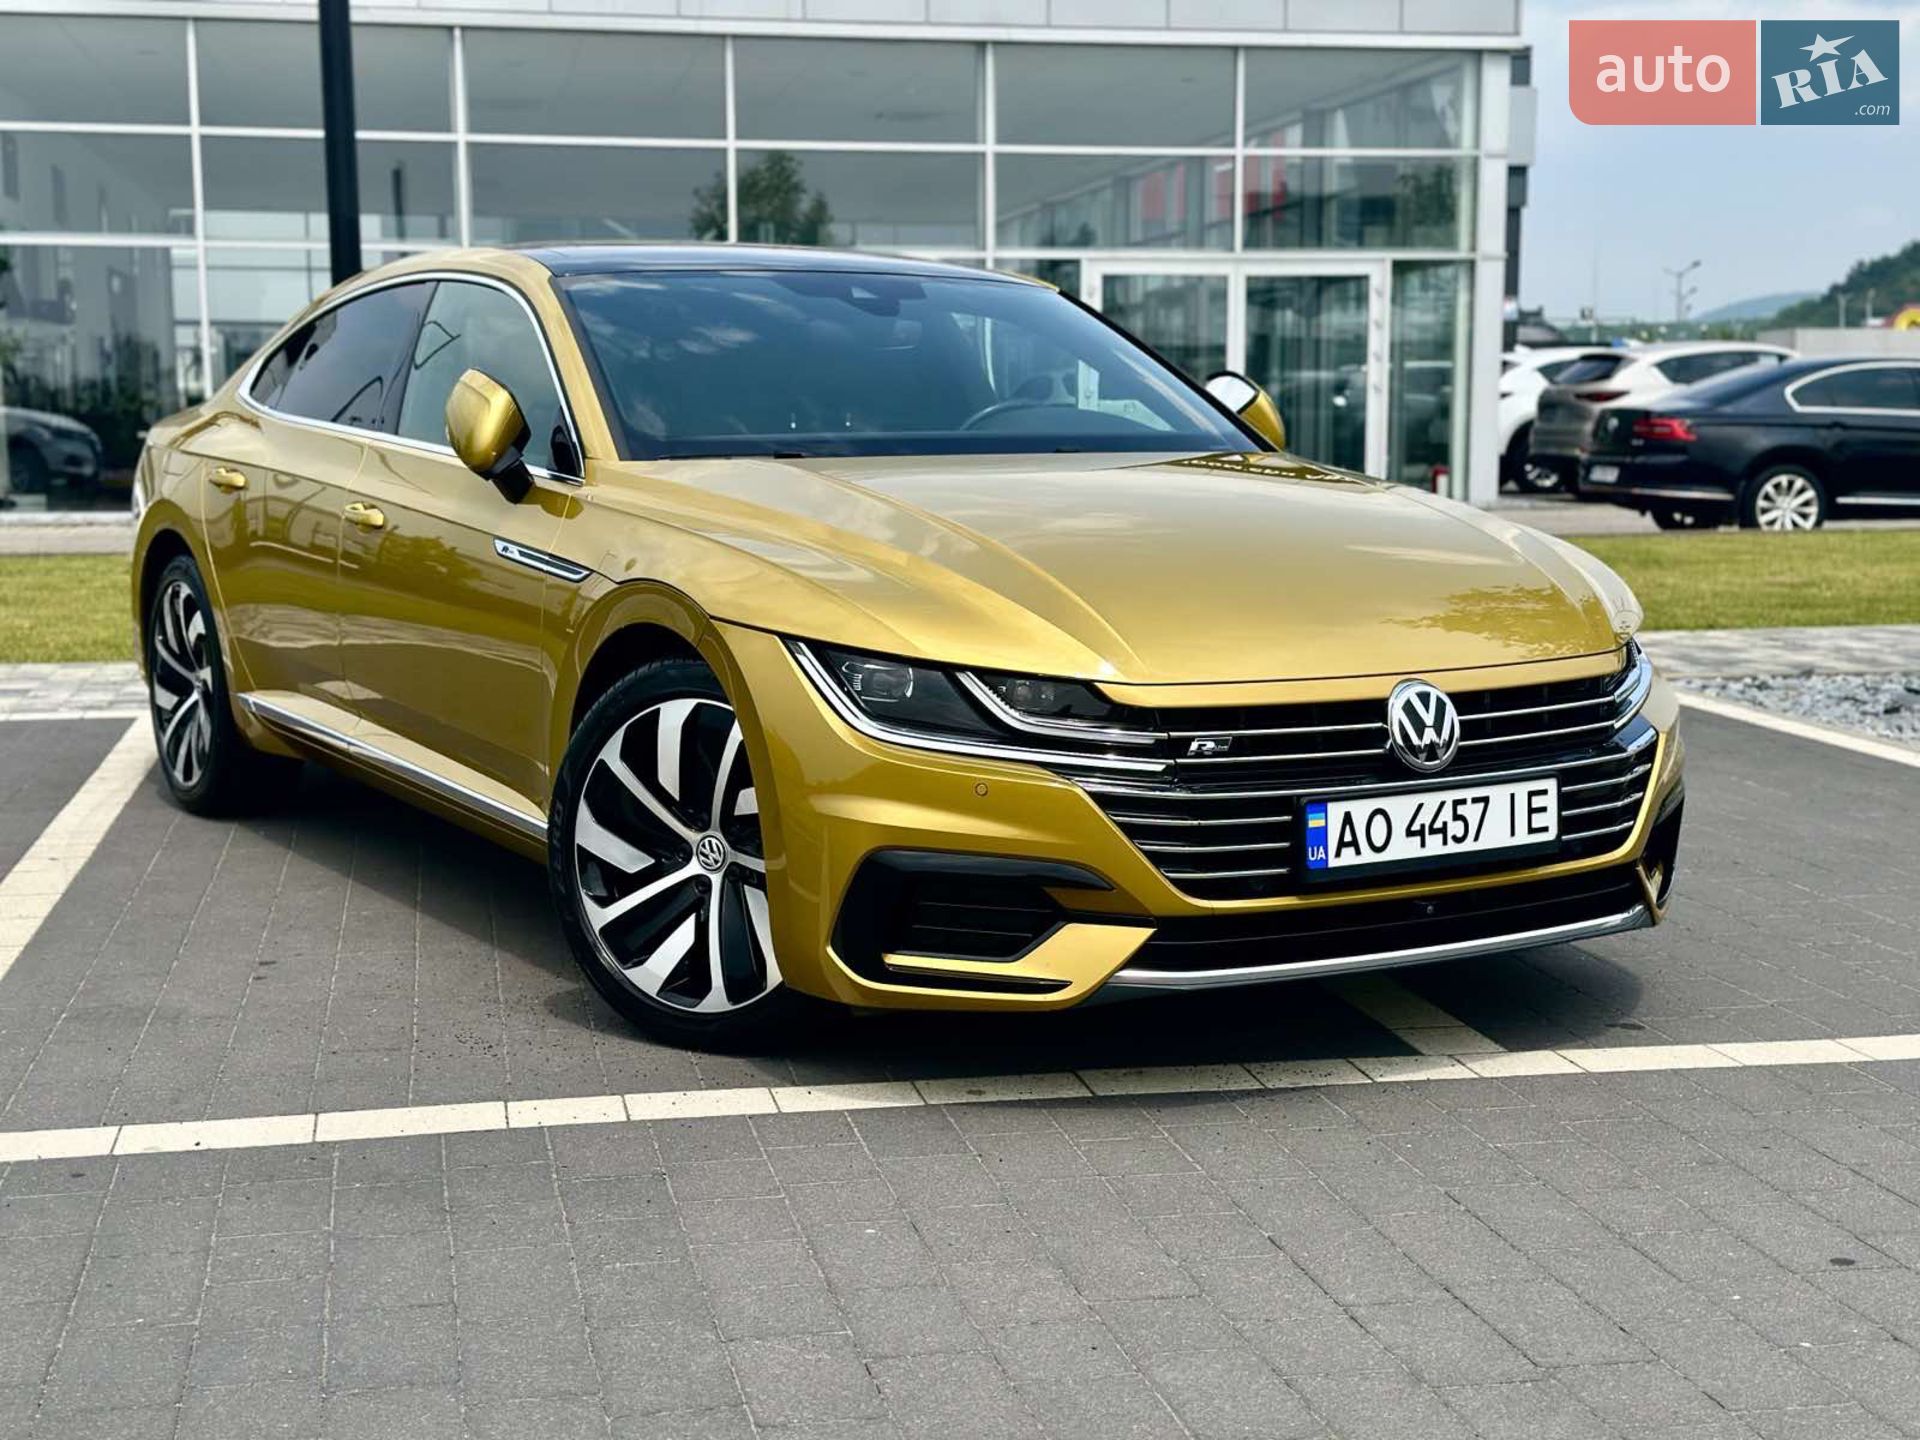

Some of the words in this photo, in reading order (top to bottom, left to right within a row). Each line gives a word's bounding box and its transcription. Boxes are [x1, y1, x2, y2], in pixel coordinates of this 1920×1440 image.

[1334, 807, 1393, 859] AO
[1405, 795, 1490, 849] 4457
[1509, 787, 1550, 838] IE
[1308, 845, 1327, 861] UA
